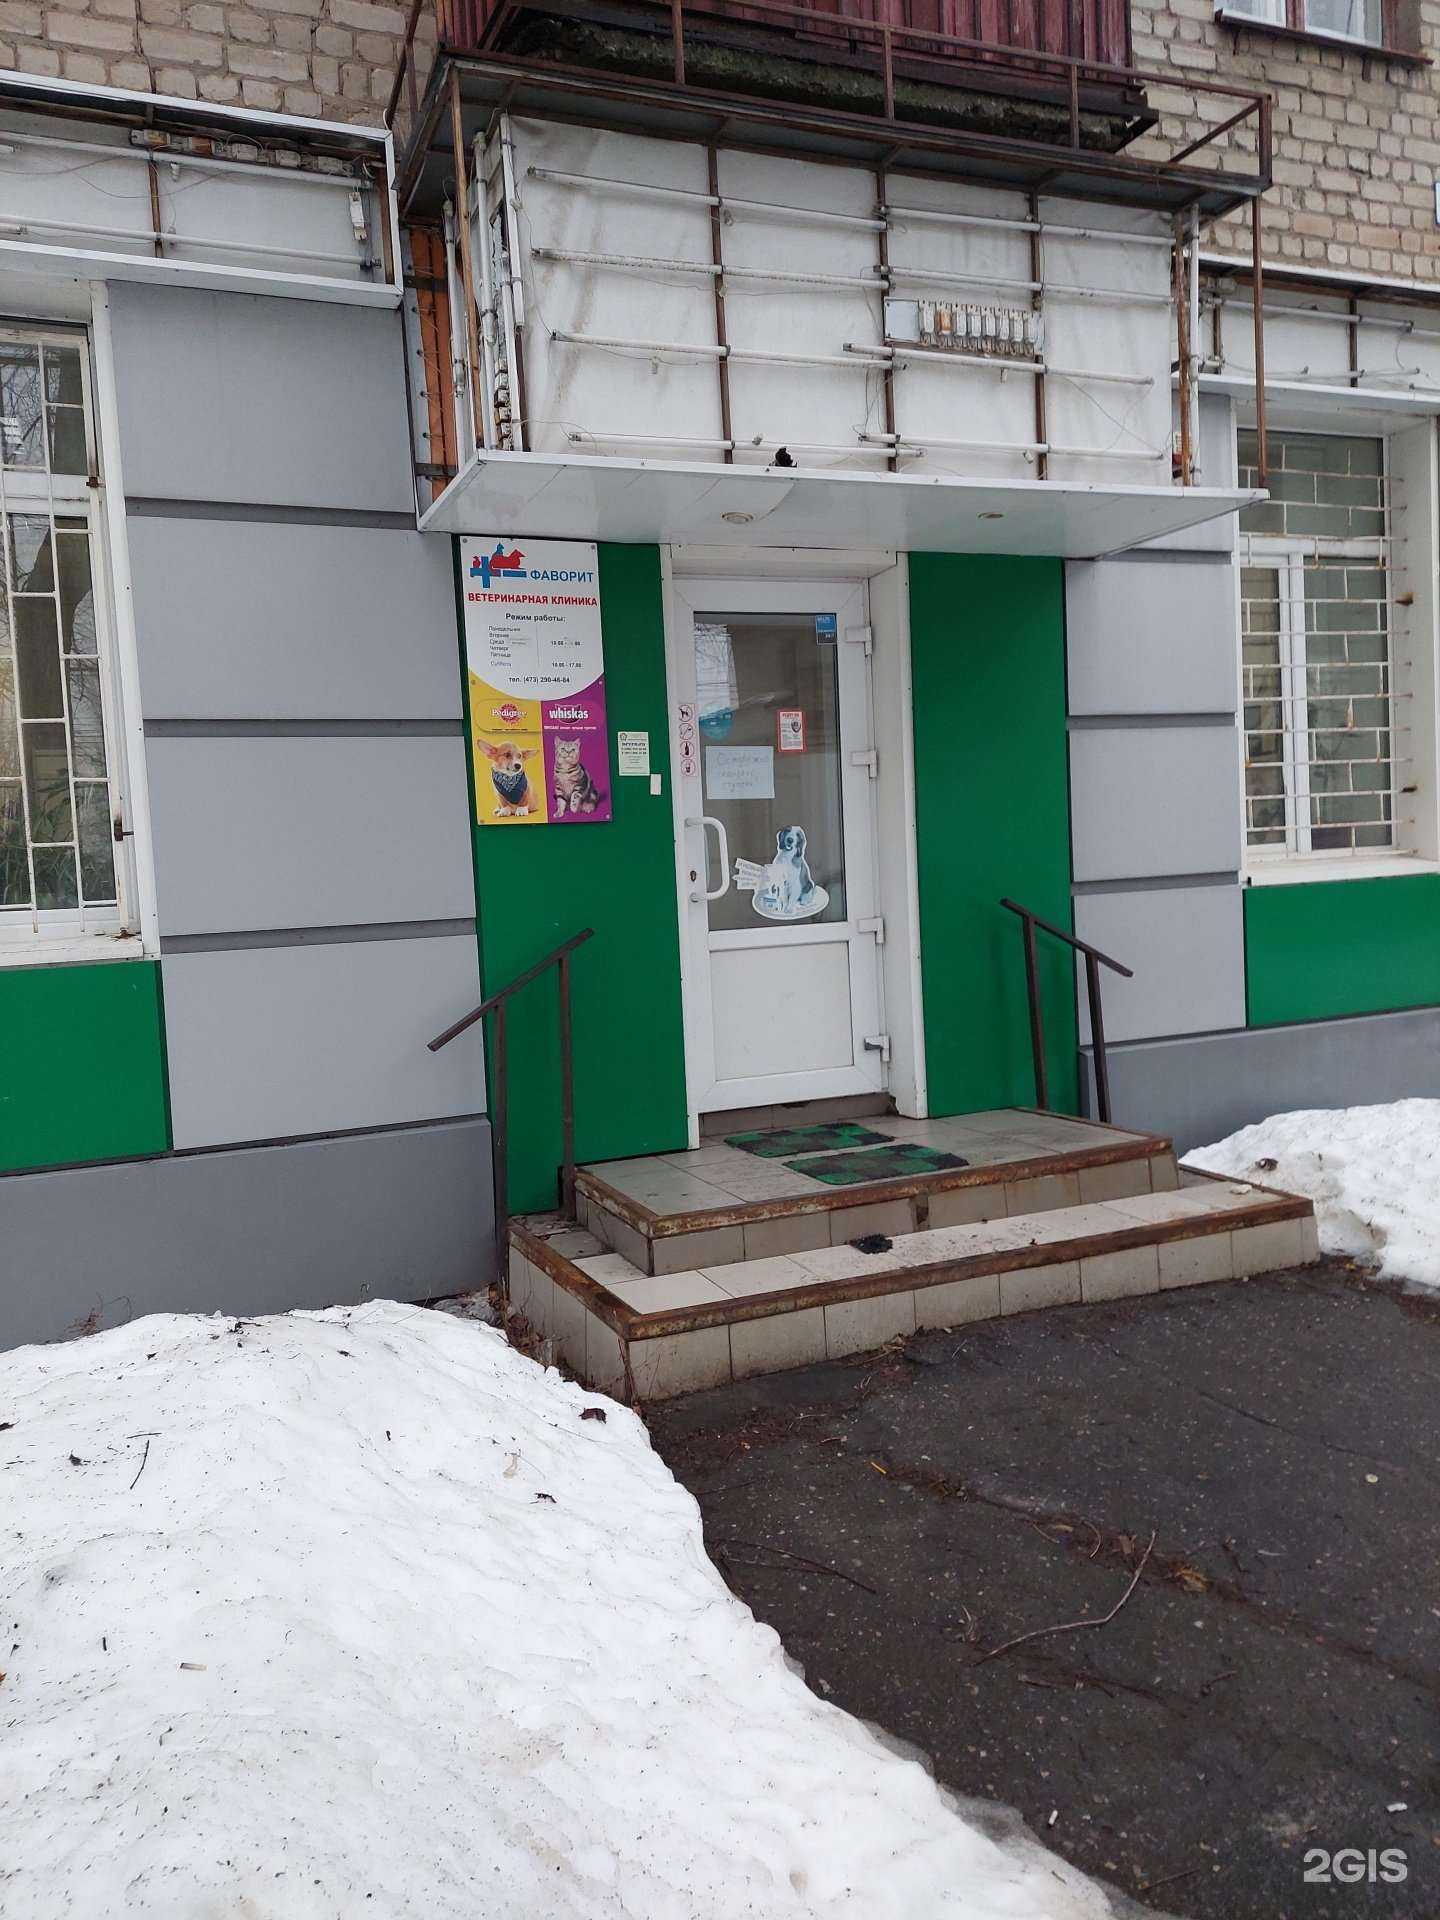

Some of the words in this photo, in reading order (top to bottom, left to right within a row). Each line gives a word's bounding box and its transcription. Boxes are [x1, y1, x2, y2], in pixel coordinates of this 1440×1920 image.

[530, 569, 595, 583] ФАВОРИТ
[468, 592, 549, 605] ВЕТЕРИНАРНАЯ
[551, 594, 598, 607] КЛИНИКА
[505, 612, 532, 621] Режим
[549, 707, 589, 719] whiskas
